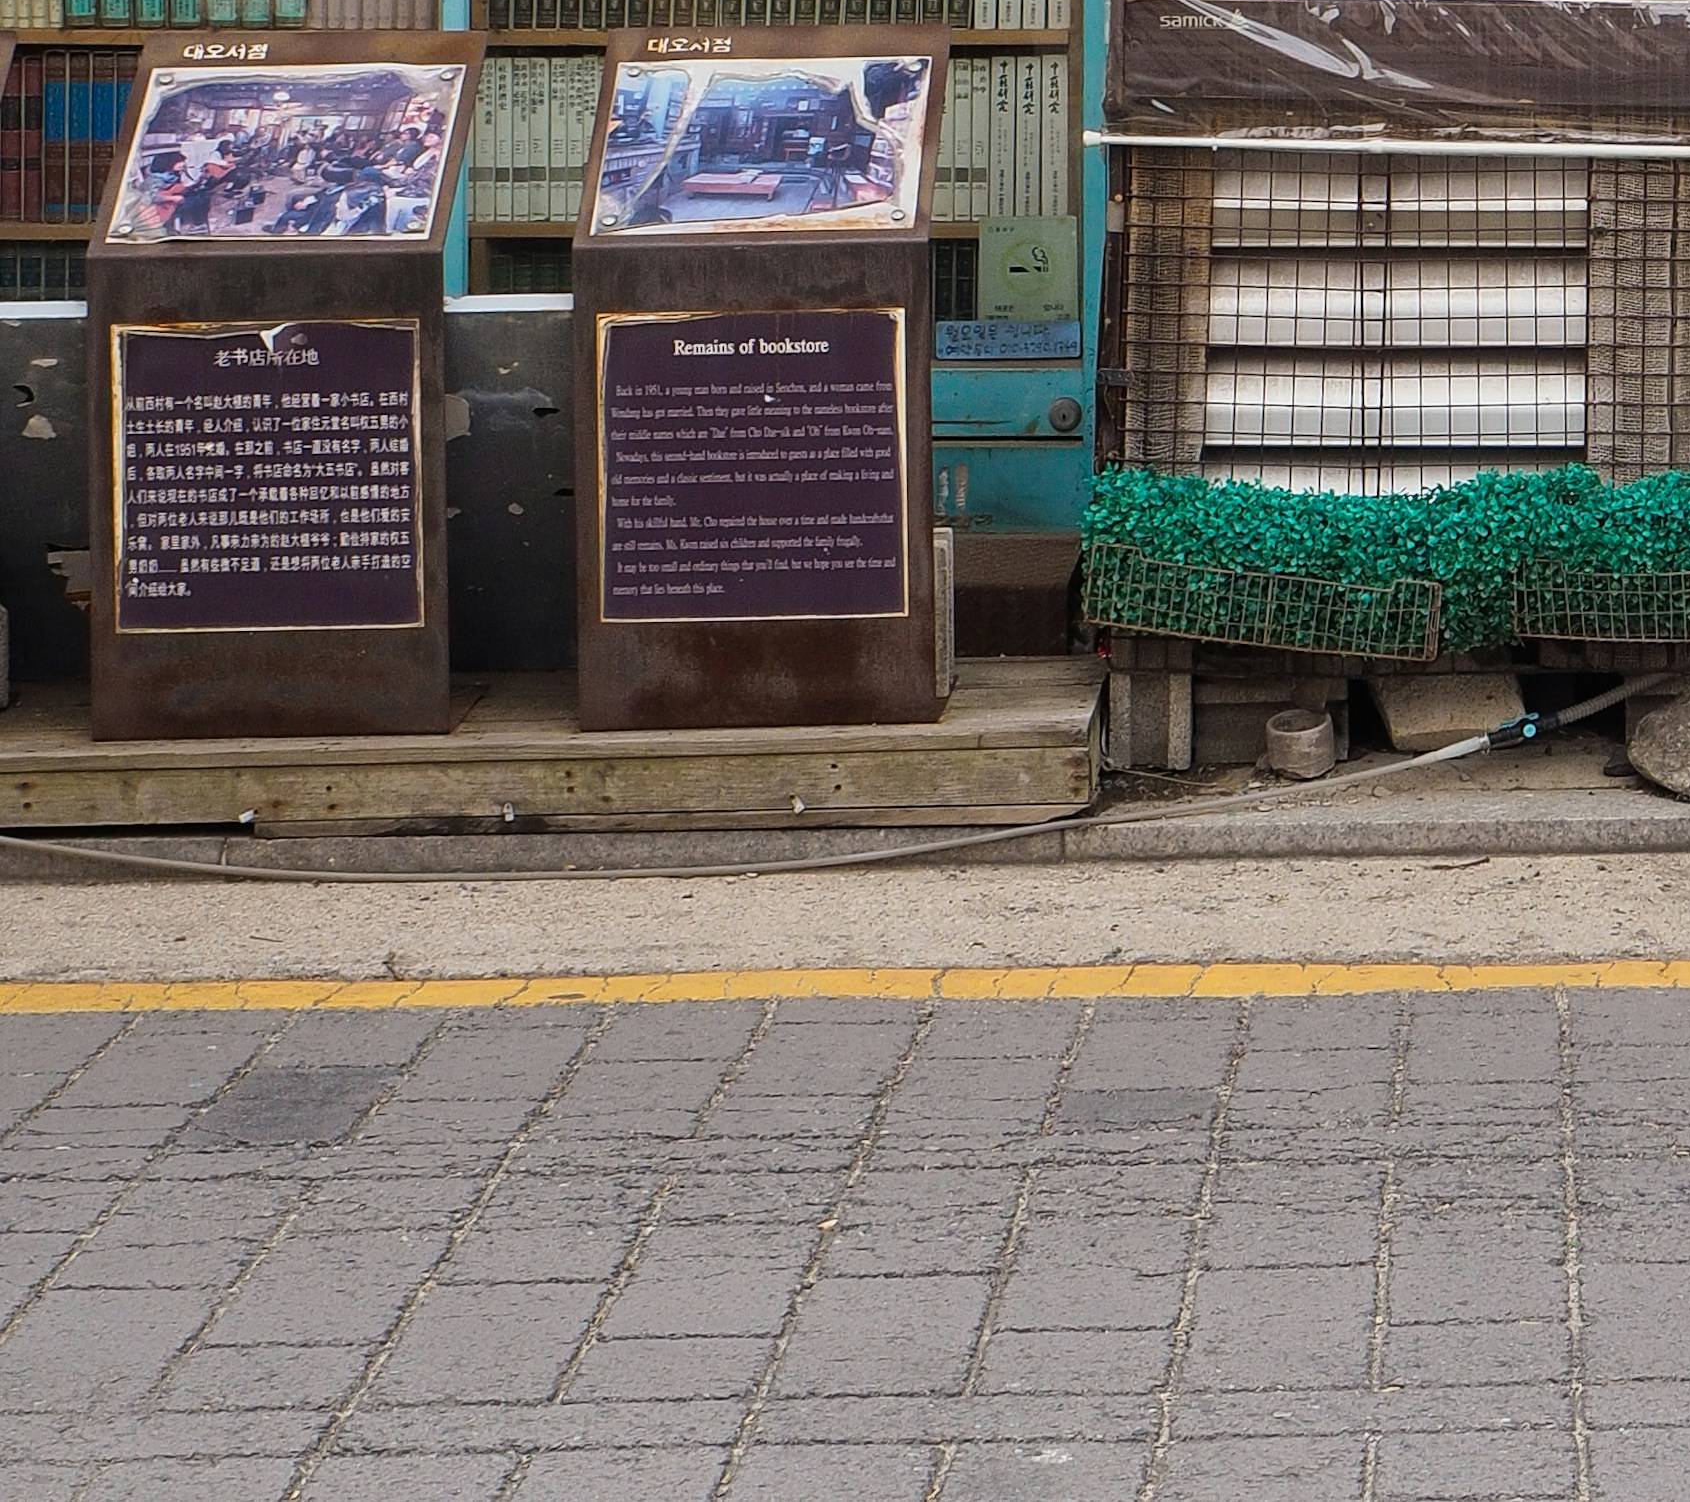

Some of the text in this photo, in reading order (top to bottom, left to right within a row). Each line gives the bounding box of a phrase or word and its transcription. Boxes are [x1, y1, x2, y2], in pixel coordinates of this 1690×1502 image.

[183, 42, 268, 61] 대오서점
[647, 36, 732, 54] 대오서점
[673, 339, 828, 355] Remains of bookstore
[213, 348, 320, 366] 老书店所在地
